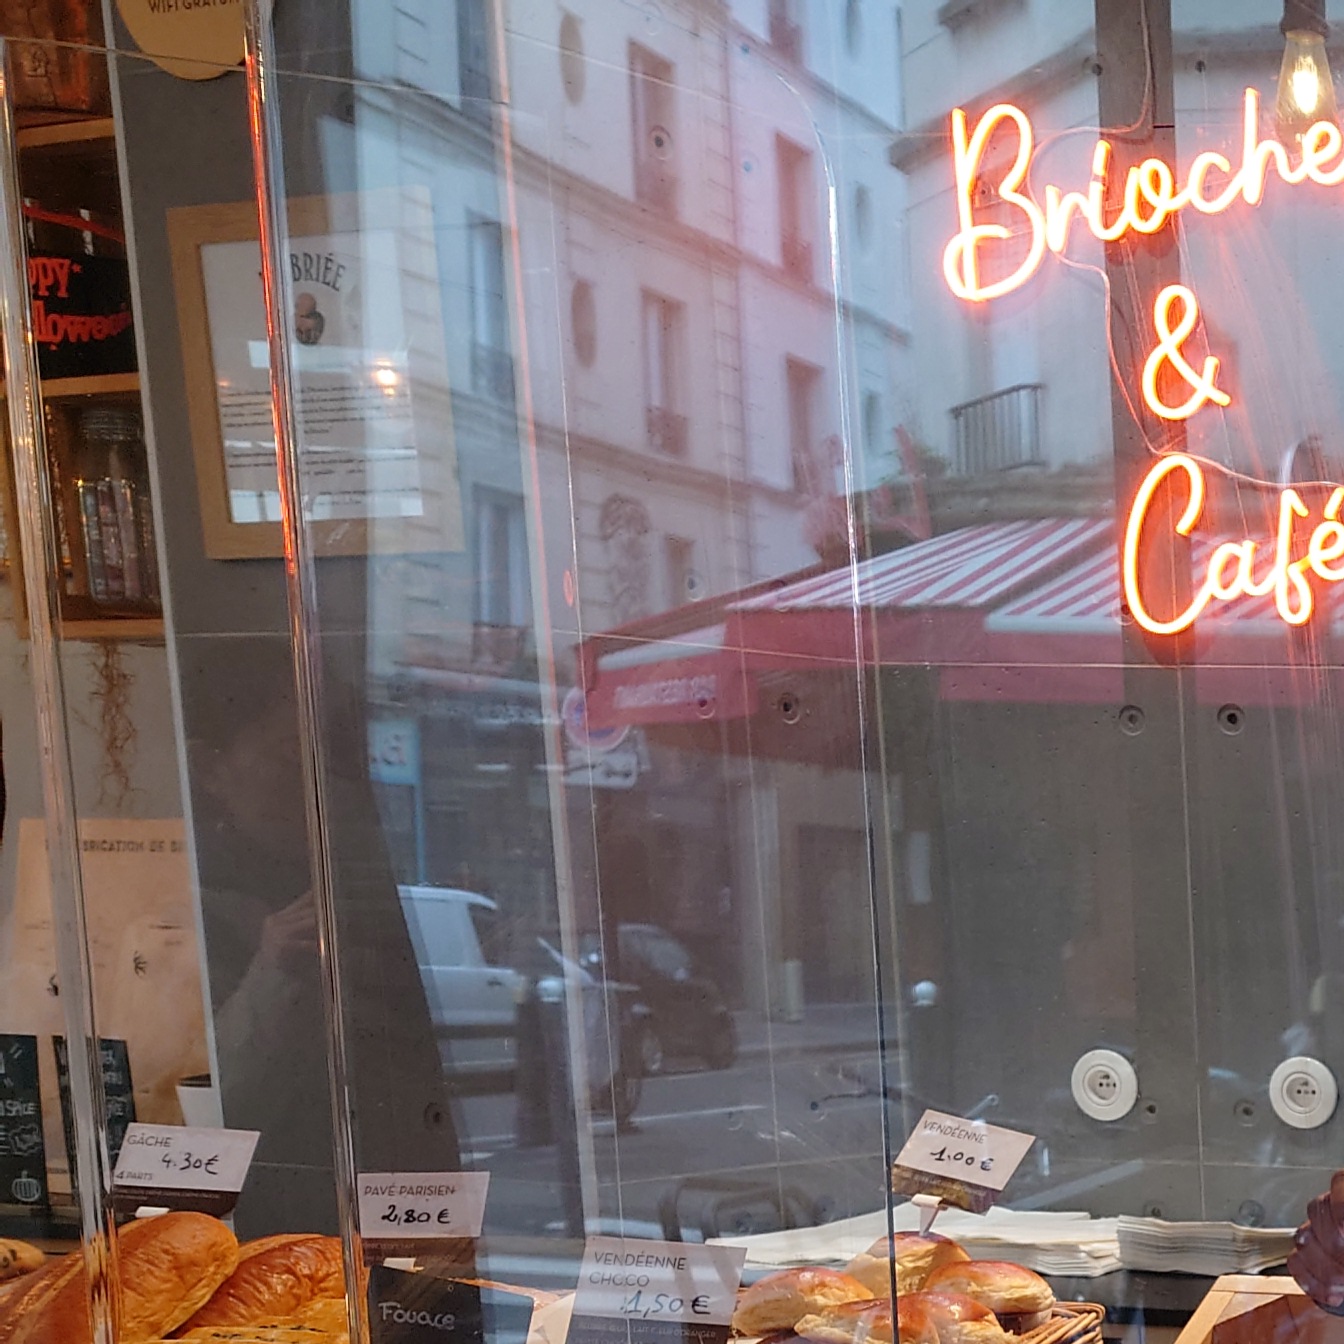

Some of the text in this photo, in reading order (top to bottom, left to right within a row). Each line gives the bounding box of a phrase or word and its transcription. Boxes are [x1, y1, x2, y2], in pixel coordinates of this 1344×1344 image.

[29, 257, 71, 297] ppy
[1142, 284, 1230, 420] &
[923, 1119, 987, 1144] VENDÉENNE
[116, 1170, 124, 1180] 4
[364, 1183, 456, 1197] PAVÉ PARISIEN
[594, 1251, 687, 1270] VENDÉENNE
[589, 1271, 650, 1288] CHOCO
[378, 1301, 455, 1331] Fouace
